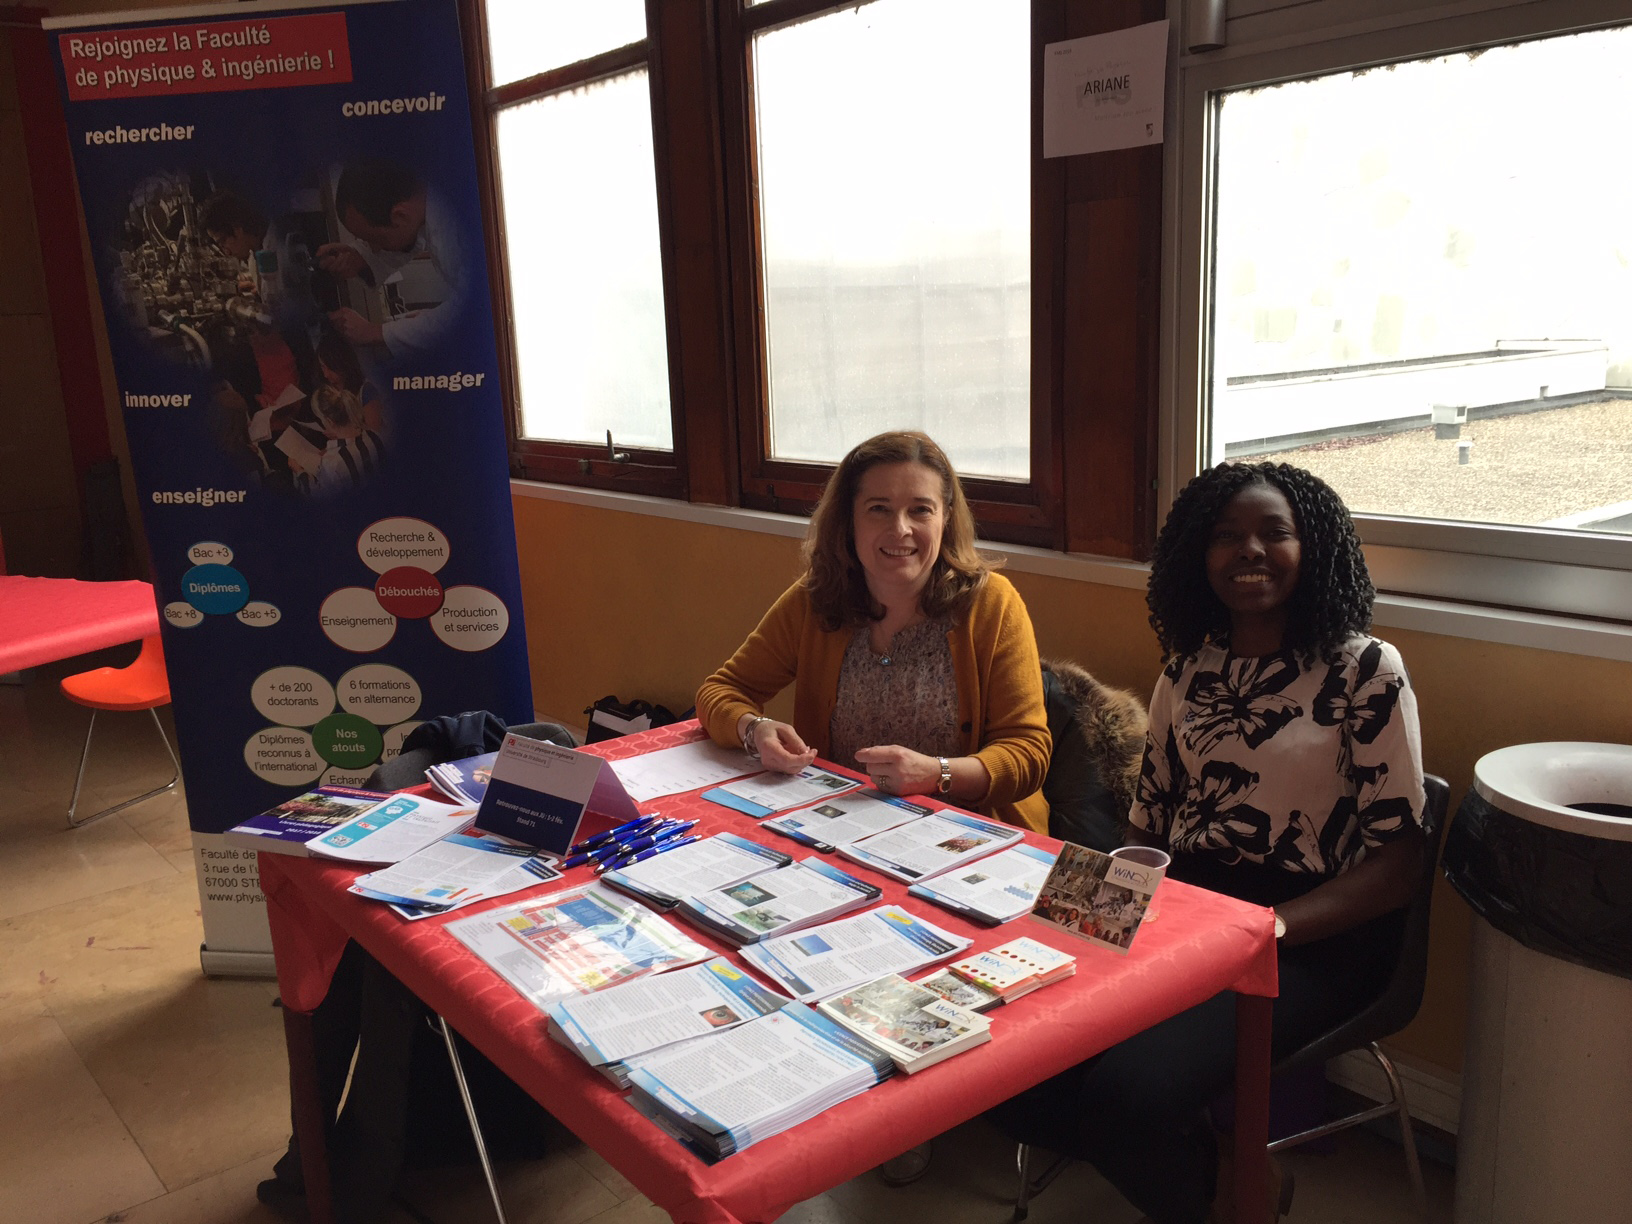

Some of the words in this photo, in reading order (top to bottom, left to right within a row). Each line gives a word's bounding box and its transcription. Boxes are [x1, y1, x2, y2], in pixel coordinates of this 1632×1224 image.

[70, 36, 168, 61] Rejoignez
[174, 32, 191, 51] la
[197, 25, 271, 49] Faculté
[75, 67, 98, 87] de
[104, 61, 195, 88] physique
[201, 59, 216, 78] &
[222, 53, 321, 79] ingénierie
[327, 50, 334, 69] !
[1084, 74, 1130, 95] ARIANE
[342, 92, 446, 117] concevoir
[85, 123, 194, 146] rechercher
[393, 372, 486, 393] manager
[125, 392, 192, 408] innover
[152, 487, 246, 506] enseigner
[370, 531, 424, 543] Recherche
[427, 531, 436, 542] &
[193, 547, 212, 558] Bac
[215, 547, 229, 557] +3
[366, 545, 444, 560] développement
[189, 581, 241, 596] Diplômes
[378, 585, 440, 597] Débouchés
[165, 609, 182, 619] Bac
[183, 609, 197, 619] +8
[242, 609, 261, 620] Bac
[263, 609, 277, 619] +5
[442, 606, 498, 618] Production
[321, 615, 393, 629] Enseignement
[444, 622, 454, 632] et
[456, 621, 499, 632] services
[279, 683, 291, 692] de
[294, 683, 312, 692] 200
[350, 680, 356, 690] 6
[359, 680, 411, 690] formations
[267, 695, 319, 706] doctorants
[364, 693, 415, 704] alternance
[336, 728, 358, 739] Nos
[259, 735, 305, 747] Diplômes
[257, 748, 302, 758] reconnus
[305, 748, 311, 758] à
[332, 742, 366, 753] atouts
[254, 761, 318, 772] l'international
[329, 775, 370, 786] Echang
[496, 799, 530, 814] Retrouvez-nous
[516, 816, 530, 826] Stand
[201, 848, 239, 859] Faculté
[242, 850, 256, 859] de
[203, 863, 209, 872] 3
[212, 865, 229, 873] rue
[232, 864, 246, 873] de
[1114, 866, 1136, 881] WiN
[205, 877, 237, 887] 67000
[980, 955, 1004, 968] WiN
[935, 1003, 959, 1017] WiN
